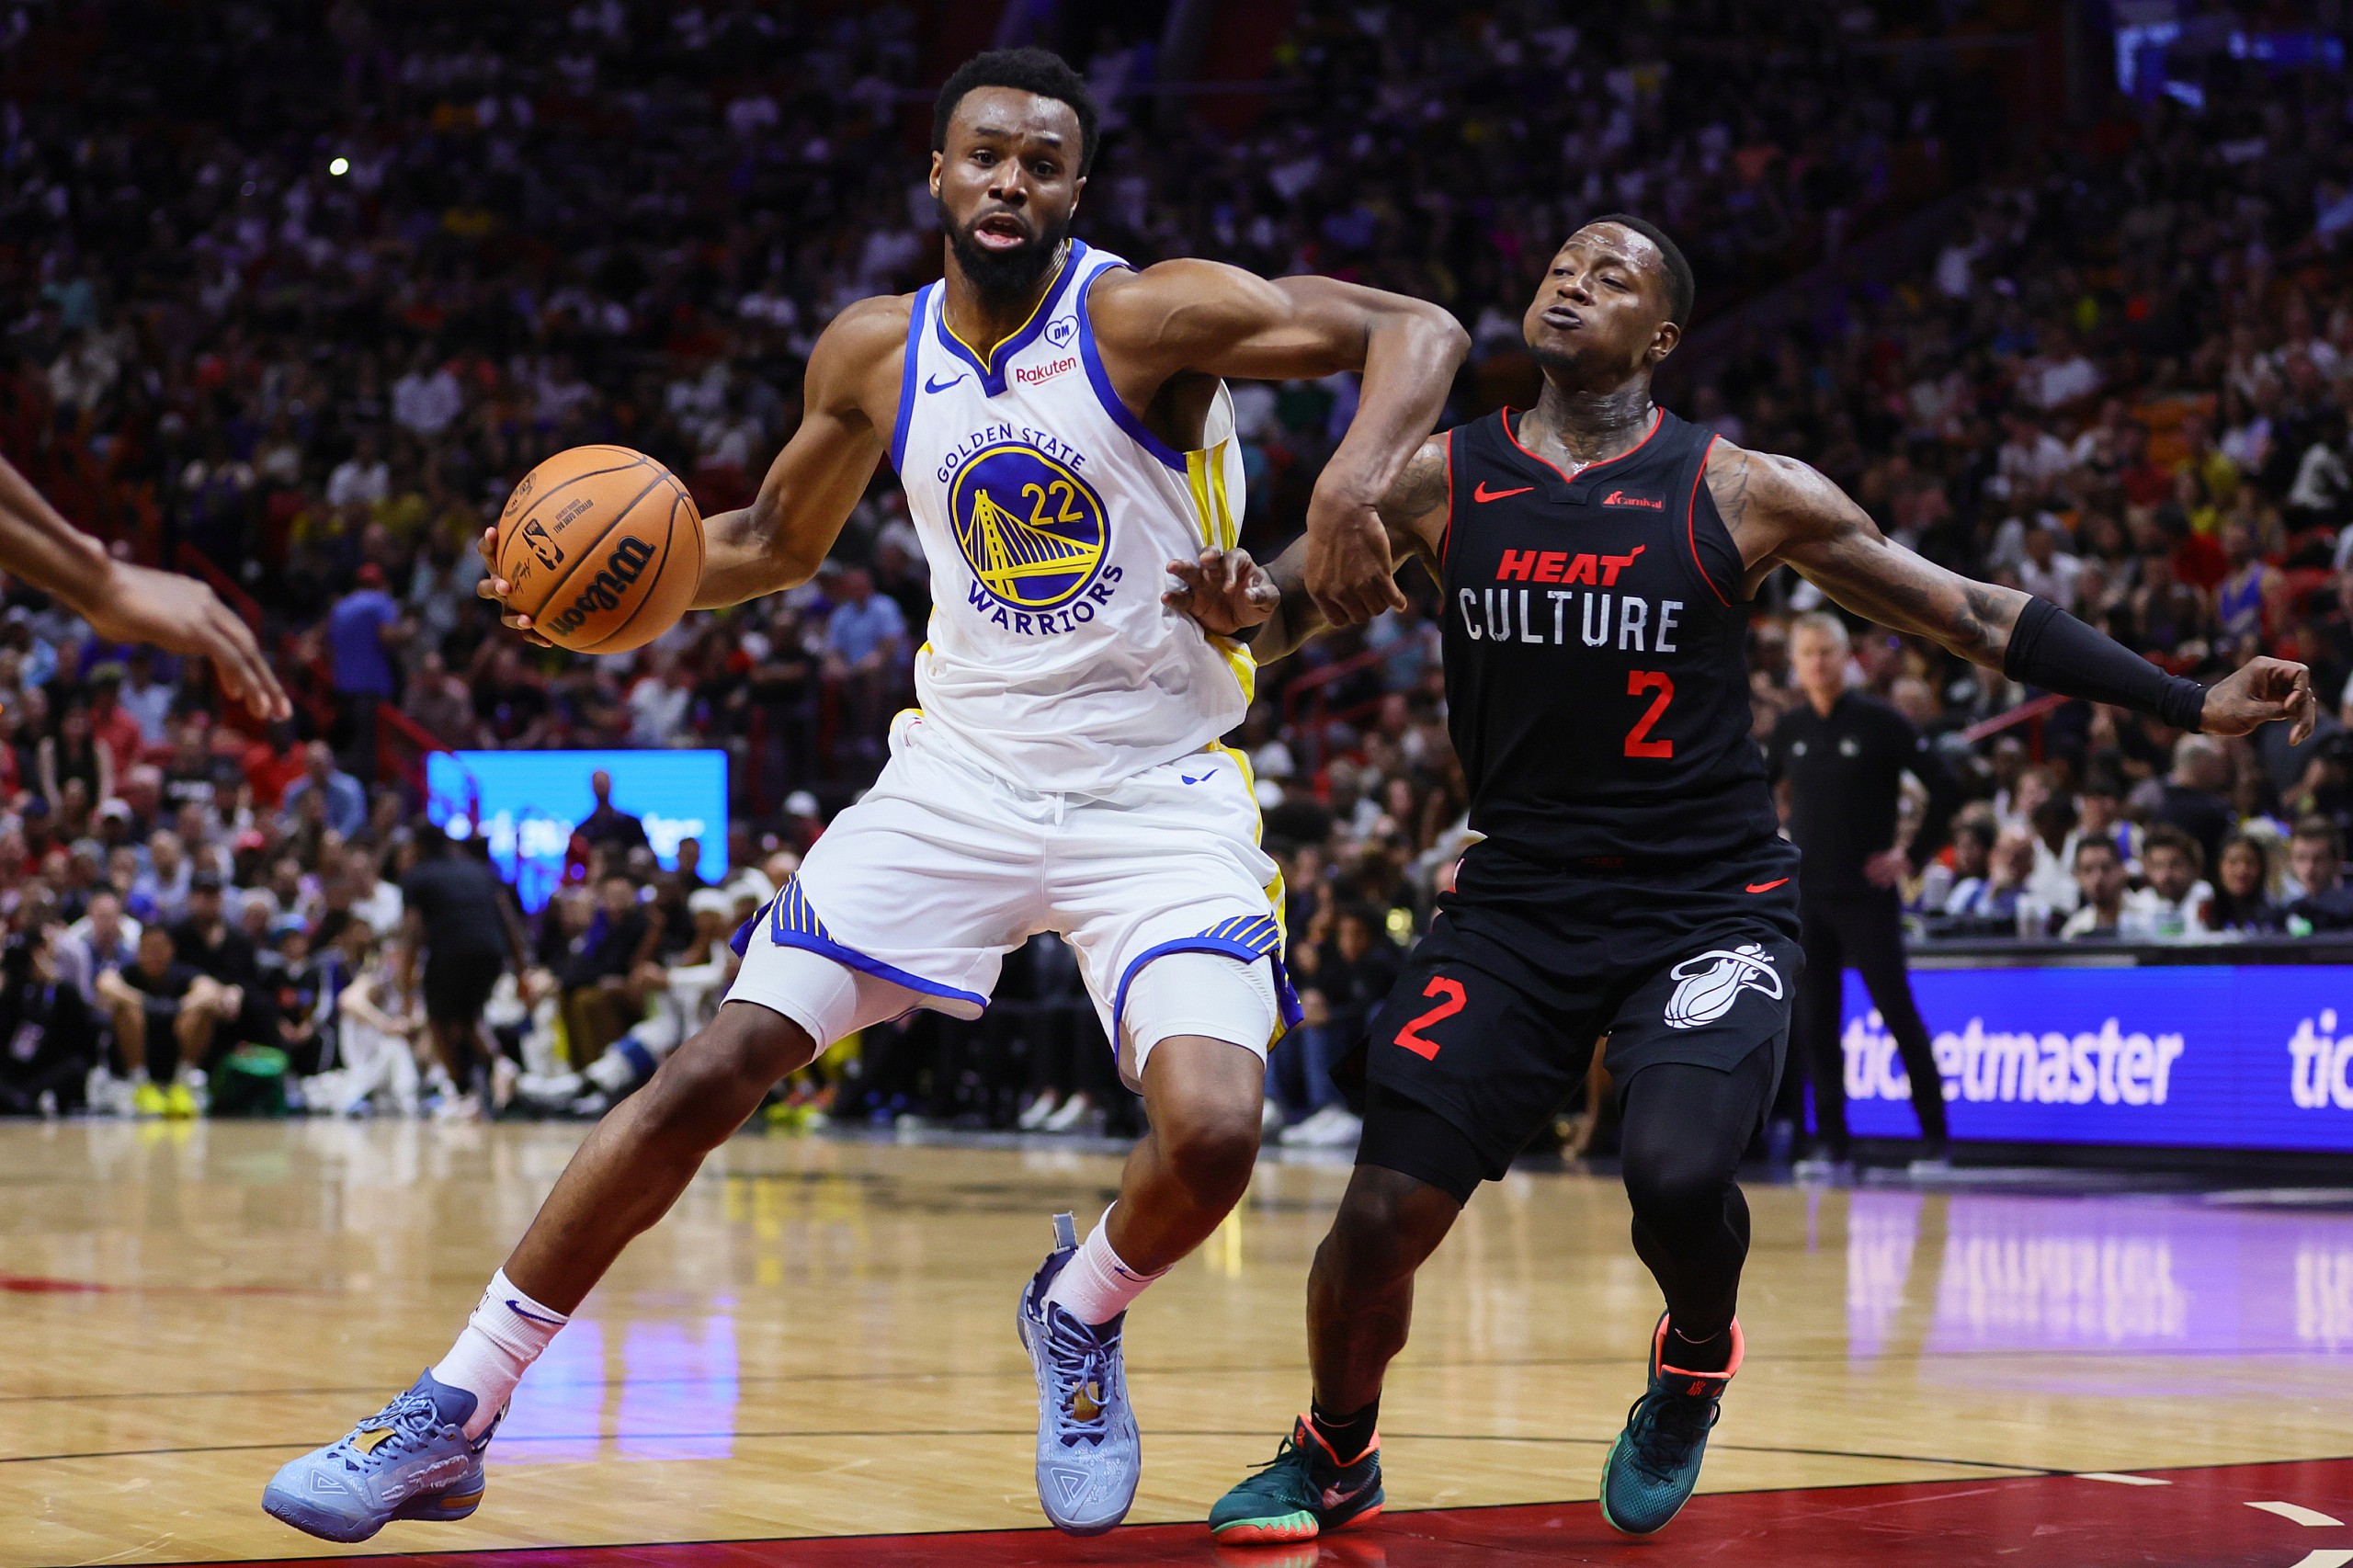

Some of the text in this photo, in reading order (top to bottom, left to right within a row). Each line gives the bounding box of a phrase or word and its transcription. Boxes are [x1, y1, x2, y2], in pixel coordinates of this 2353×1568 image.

[1054, 324, 1070, 340] DM
[1016, 357, 1077, 383] Rakuten
[937, 423, 1086, 483] GOLDEN STATE
[1021, 479, 1084, 527] 22
[1617, 496, 1663, 509] Carnival
[546, 535, 657, 637] Wilson
[1495, 544, 1646, 586] HEAT
[968, 564, 1124, 636] WARRIORS
[1459, 587, 1684, 653] CULTURE
[1623, 670, 1675, 758] 2
[1392, 976, 1468, 1062] 2
[1841, 1008, 2184, 1105] ticetmaster
